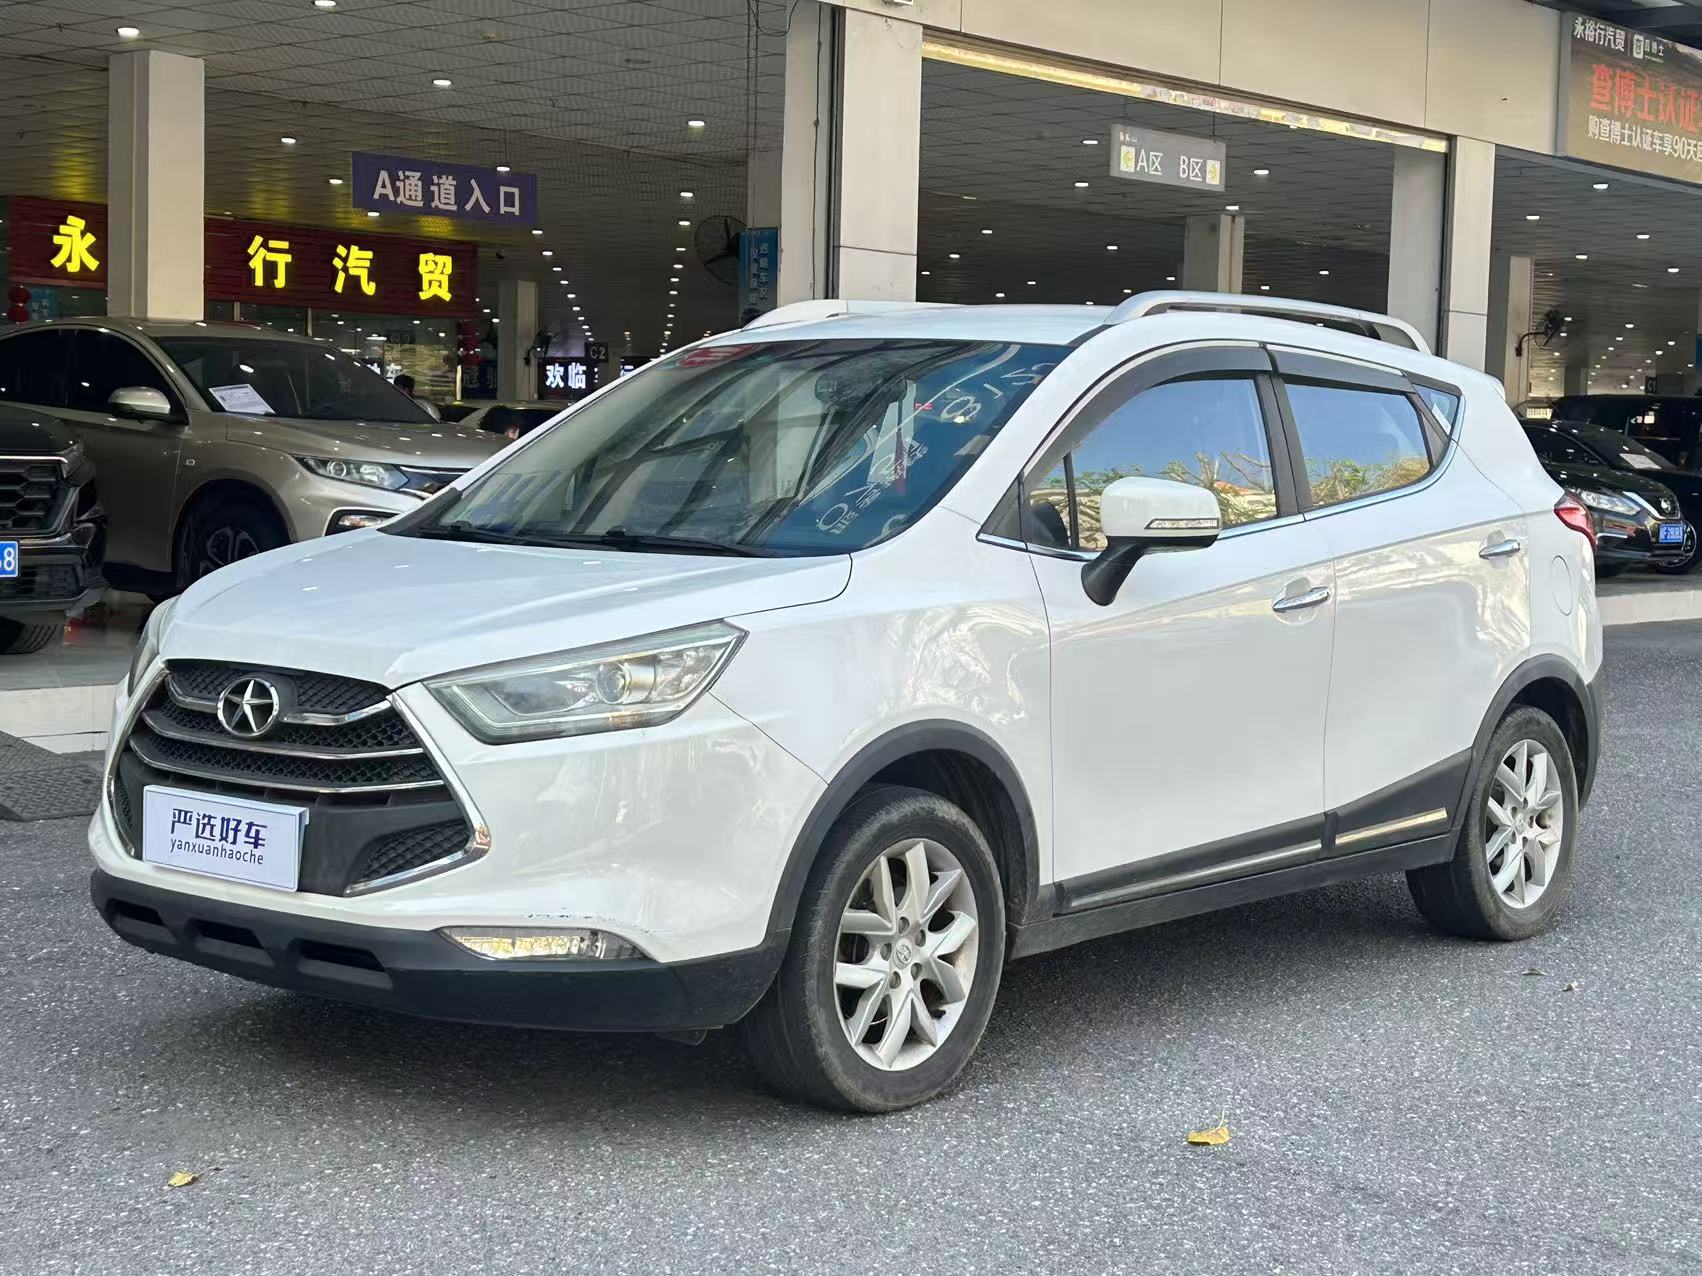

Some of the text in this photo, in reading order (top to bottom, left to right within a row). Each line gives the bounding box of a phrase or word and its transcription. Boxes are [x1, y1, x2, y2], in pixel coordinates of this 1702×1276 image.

[1589, 63, 1702, 134] 查博士认证
[1137, 148, 1203, 181] A区 B区
[373, 169, 520, 216] A通道入口
[50, 215, 100, 273] 永
[589, 345, 606, 360] C2
[545, 362, 599, 389] 欢临
[0, 547, 15, 571] 8
[171, 808, 268, 850] 严选好车
[170, 837, 264, 865] yanxuanhaoche
